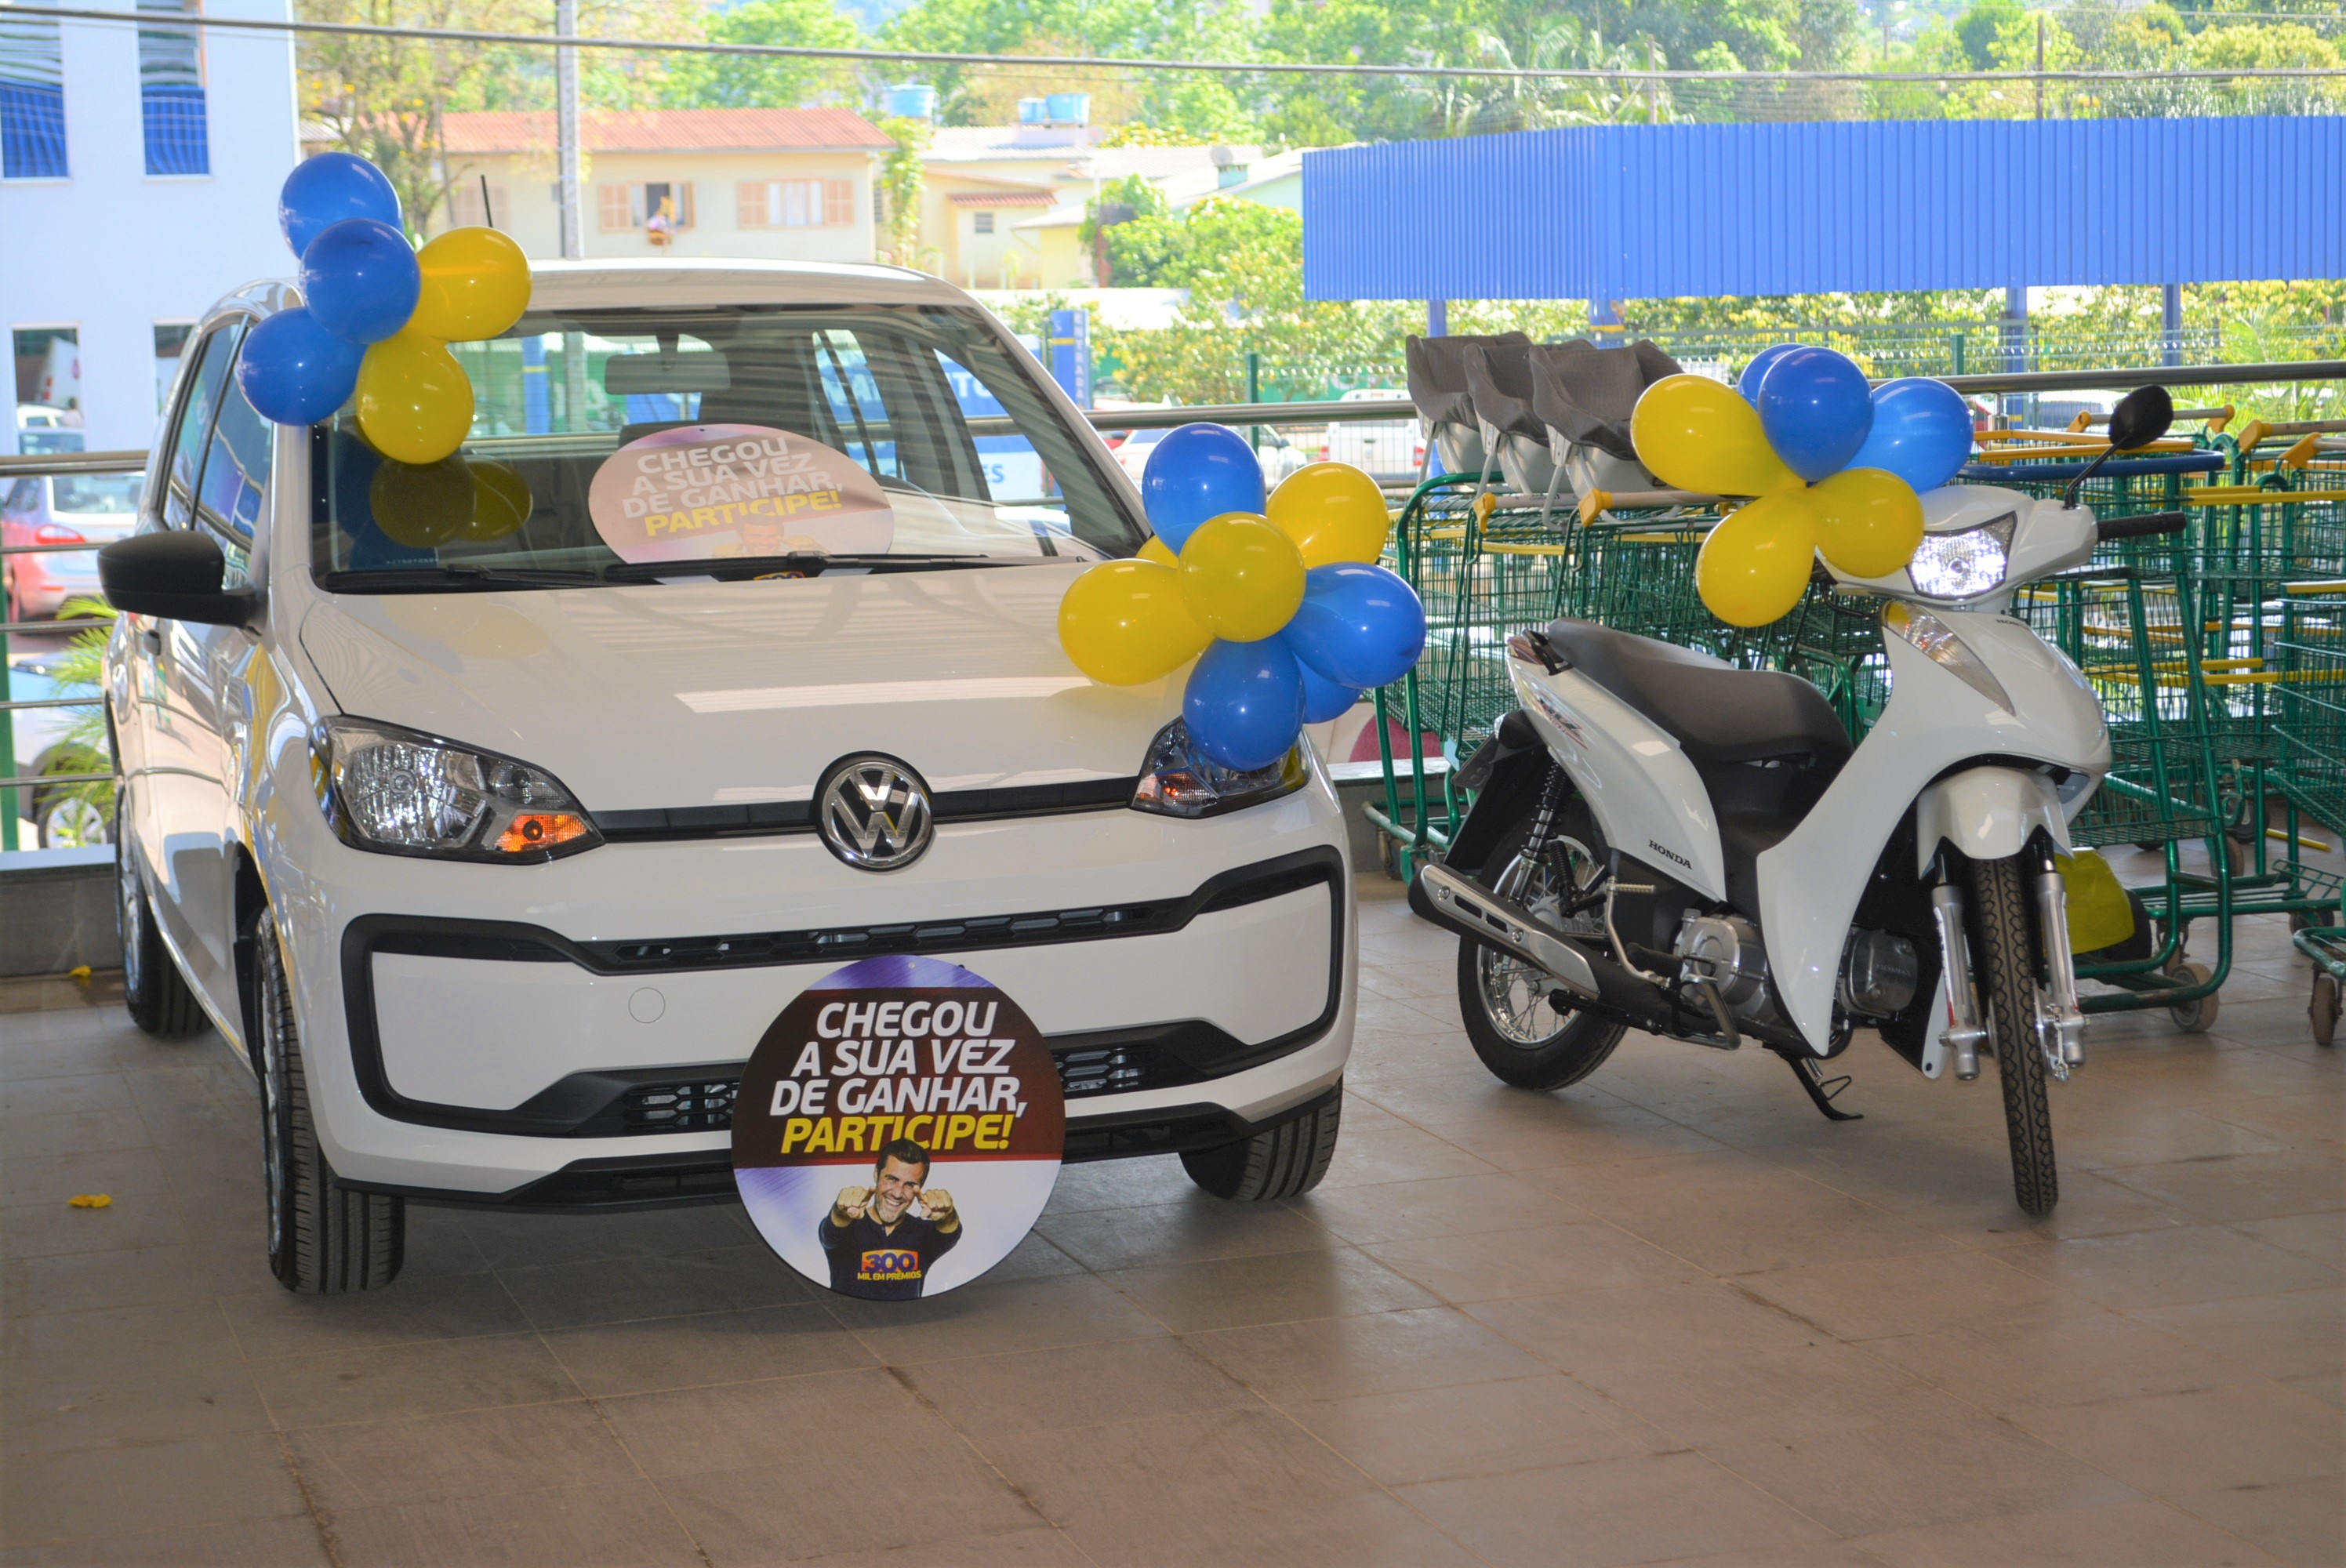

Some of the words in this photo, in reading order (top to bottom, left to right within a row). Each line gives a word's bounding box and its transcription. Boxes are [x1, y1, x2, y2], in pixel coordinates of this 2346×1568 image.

[1074, 312, 1084, 398] ENTRADA
[632, 476, 659, 495] A
[664, 464, 739, 491] SUA
[744, 452, 816, 477] VEZ
[637, 437, 789, 474] CHEGOU
[622, 494, 673, 518] DE
[681, 471, 843, 508] GANHAR,
[644, 490, 842, 536] PARTICIPE!
[1648, 839, 1693, 870] HONDA
[817, 1001, 997, 1039] CHEGOU
[790, 1042, 821, 1077] A
[831, 1040, 916, 1076] SUA
[932, 1039, 1016, 1074] VEZ
[769, 1079, 829, 1116] DE
[837, 1077, 1028, 1118] GANHAR,
[781, 1115, 1015, 1154] PARTICIPE!
[865, 1253, 916, 1272] 300
